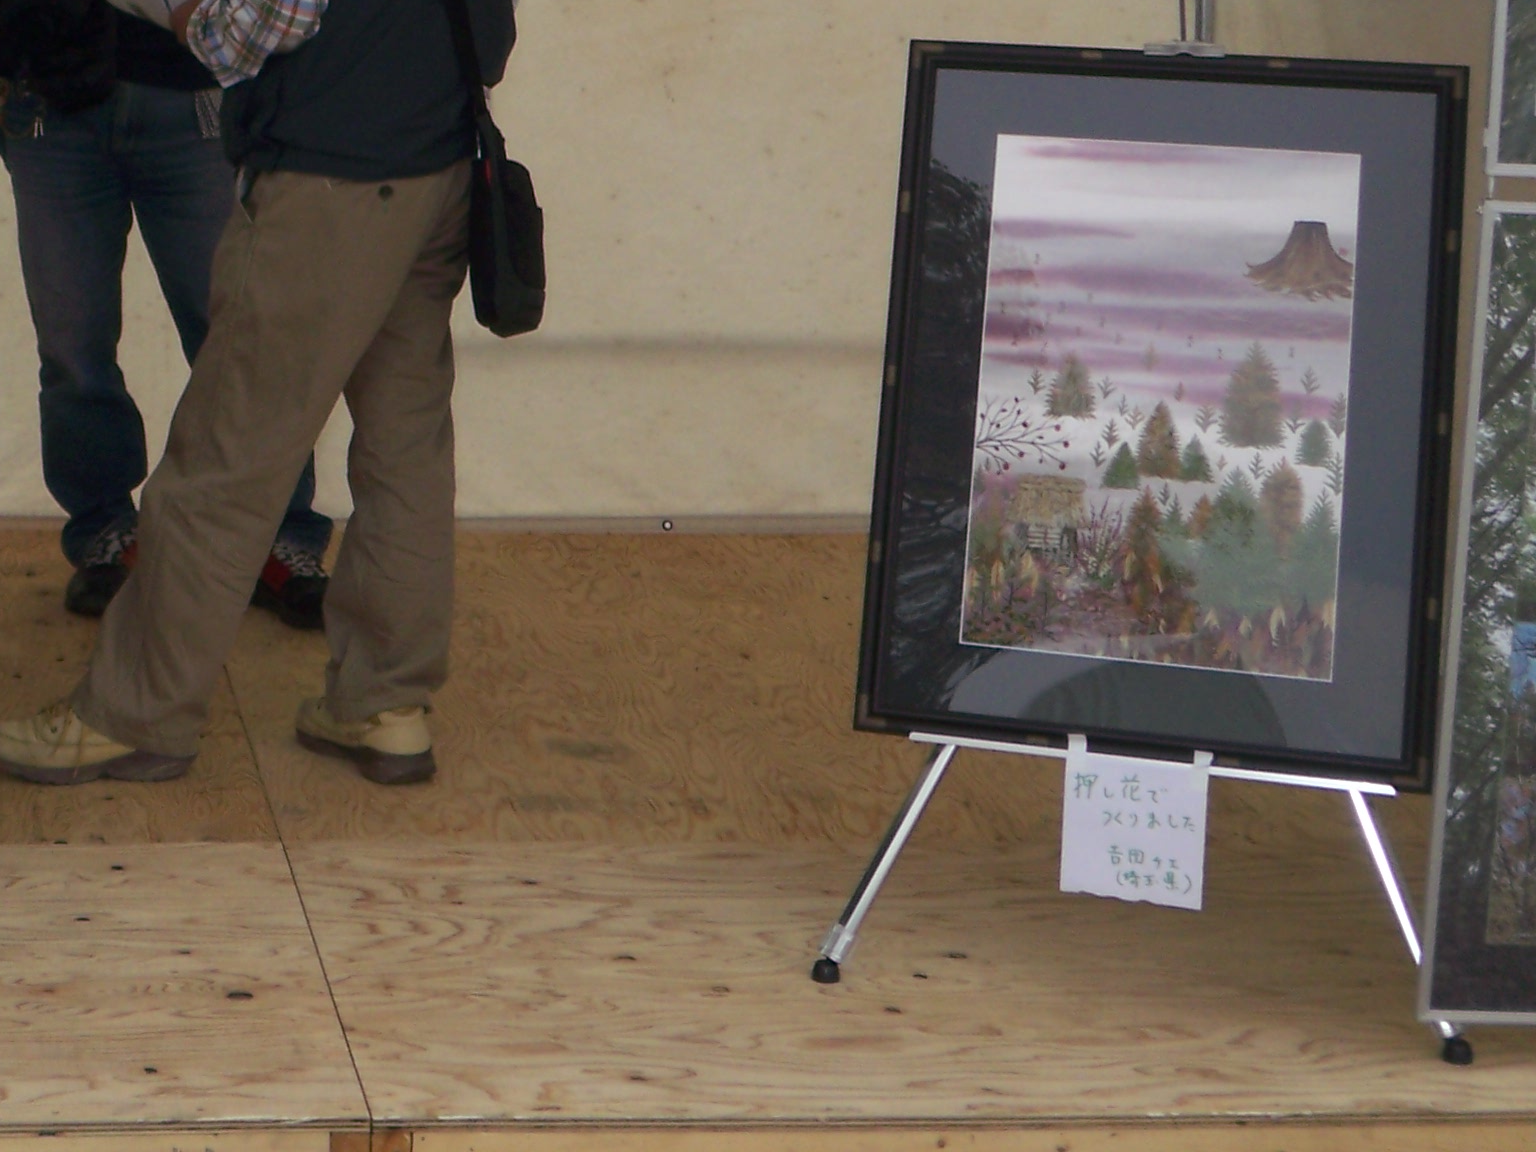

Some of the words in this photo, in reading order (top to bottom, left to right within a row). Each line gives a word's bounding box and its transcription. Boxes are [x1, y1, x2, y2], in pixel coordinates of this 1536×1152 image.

[1074, 772, 1168, 803] 押し花で
[1102, 811, 1196, 832] つくりました
